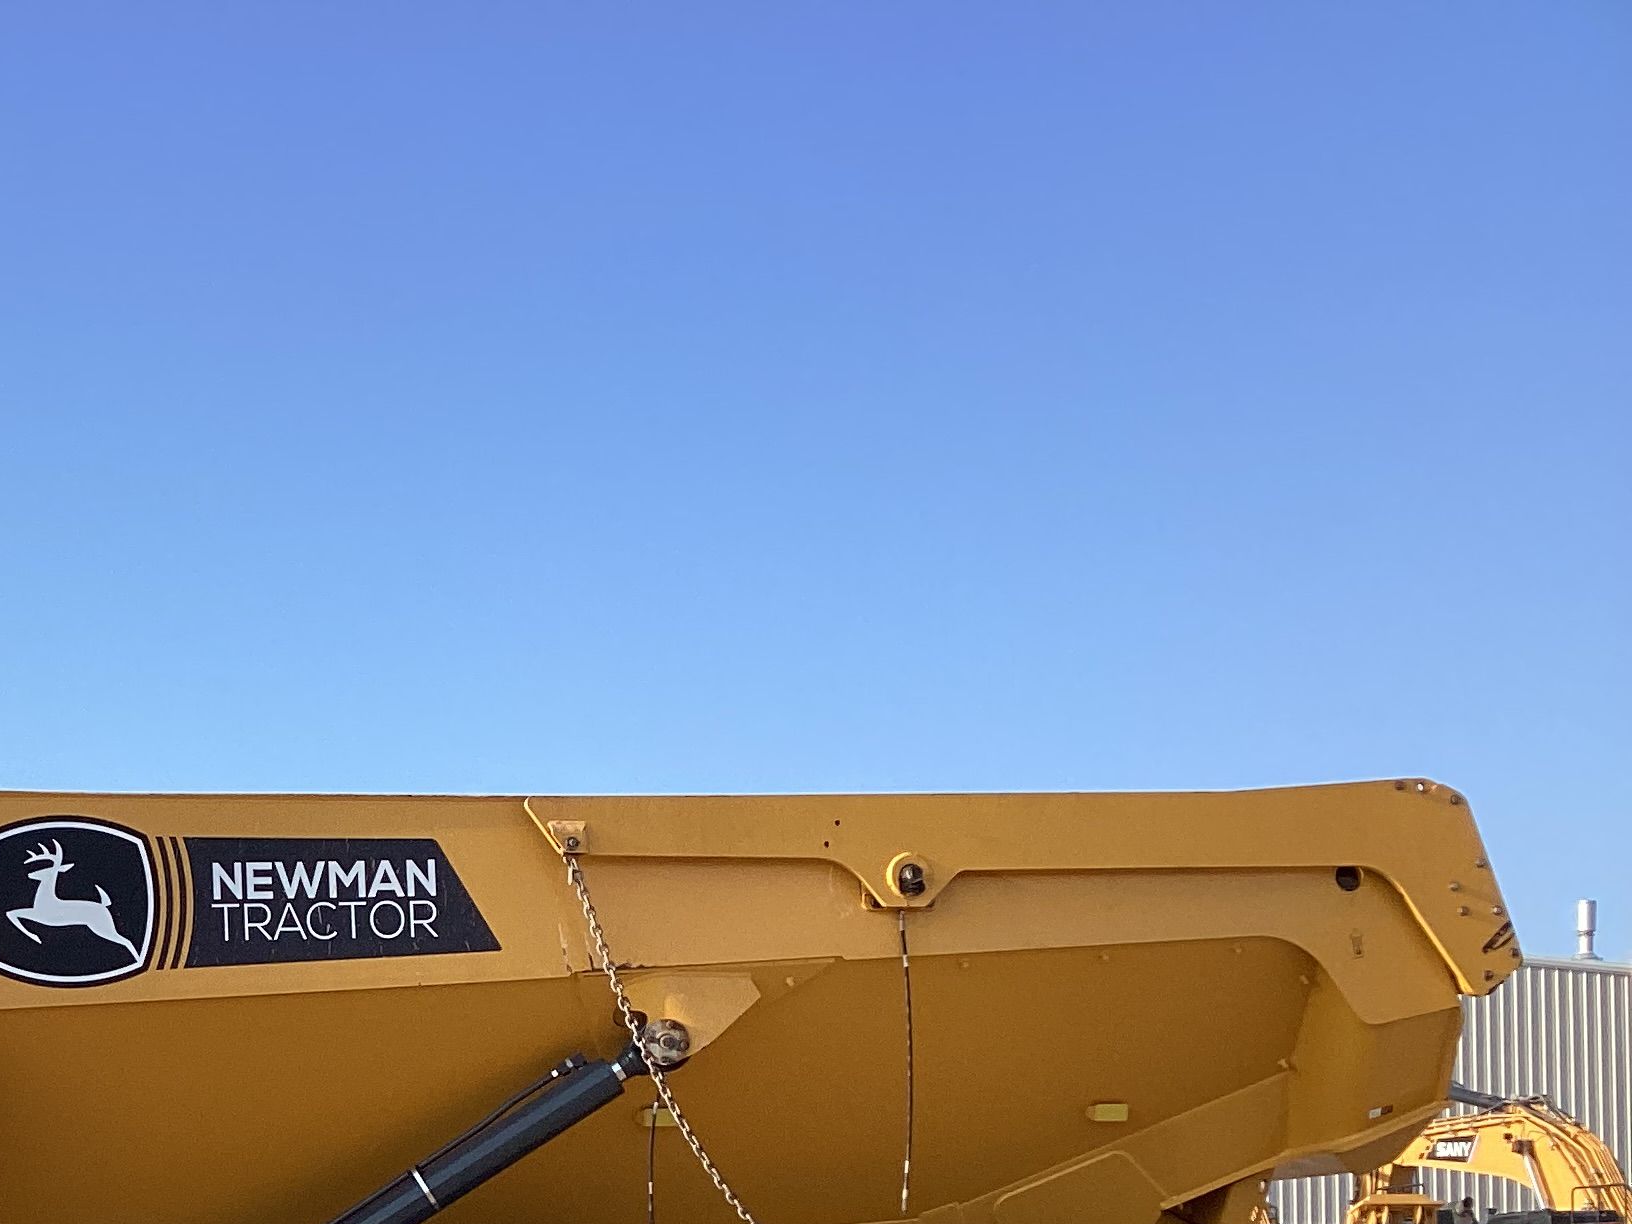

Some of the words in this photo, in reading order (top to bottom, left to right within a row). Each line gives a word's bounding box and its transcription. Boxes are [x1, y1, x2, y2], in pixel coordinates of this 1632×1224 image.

[211, 858, 437, 900] NEWMAN
[211, 900, 438, 942] TRACTOR
[1436, 1141, 1472, 1157] SANY
